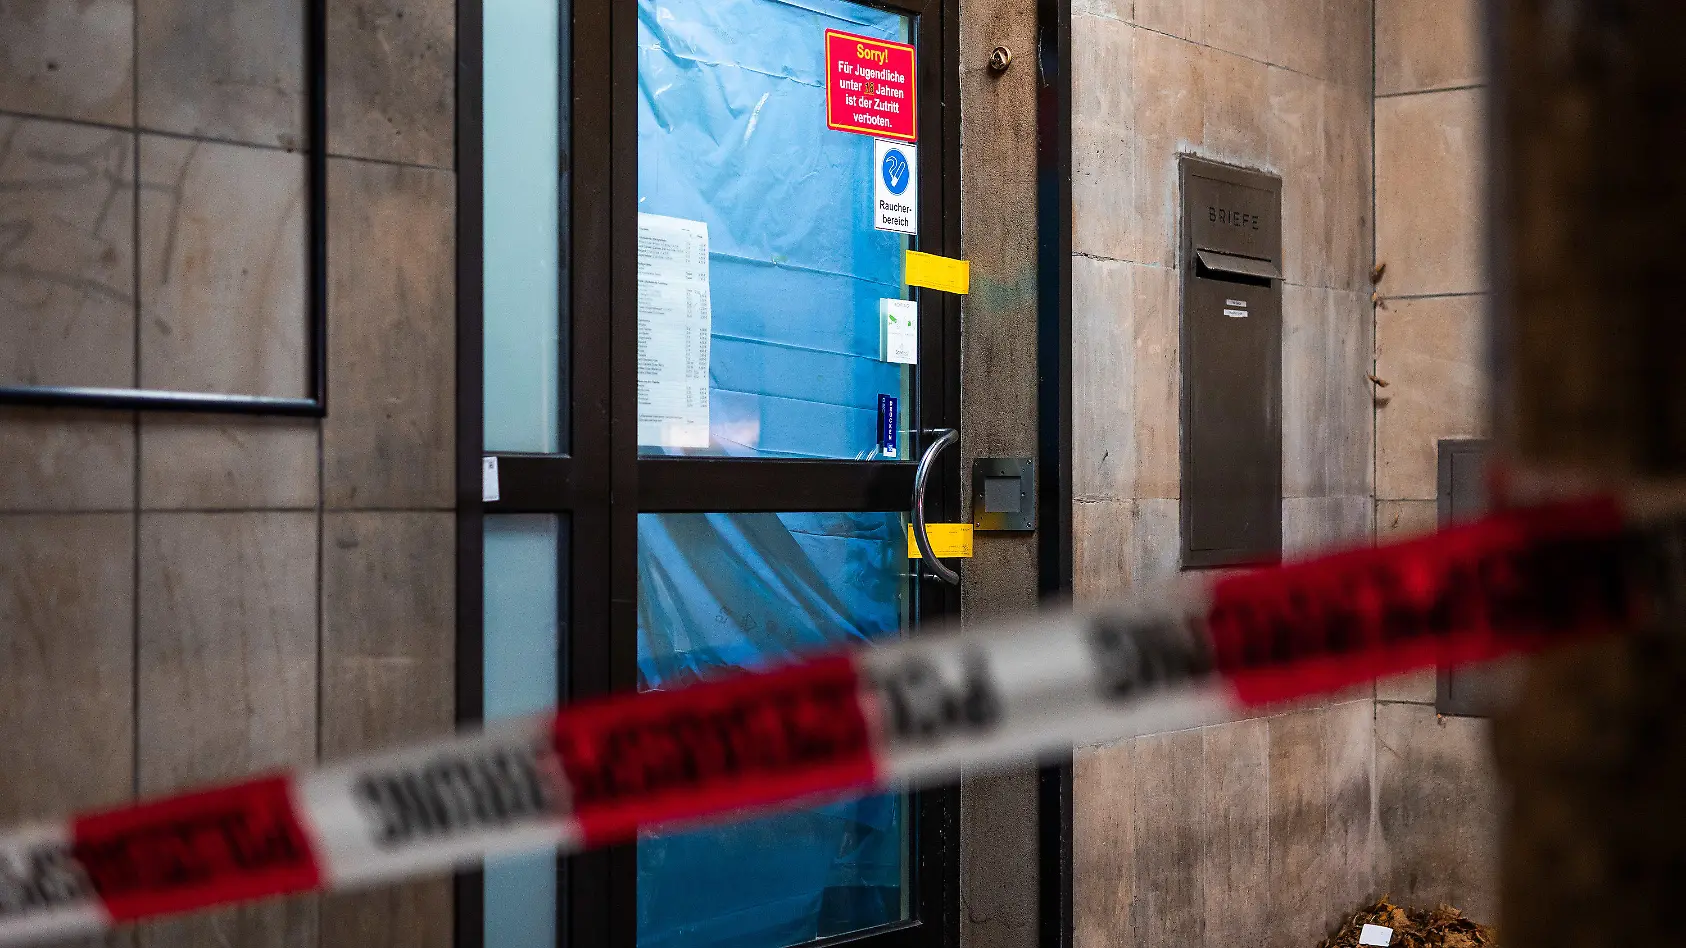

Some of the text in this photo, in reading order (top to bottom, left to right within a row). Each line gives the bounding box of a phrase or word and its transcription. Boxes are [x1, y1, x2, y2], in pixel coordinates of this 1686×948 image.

[856, 44, 889, 65] Sorry!
[838, 60, 905, 84] Für Jugendliche
[839, 79, 862, 92] unter
[876, 84, 904, 99] Jahren
[845, 94, 900, 113] ist der Zutritt
[853, 112, 893, 128] verboten.
[879, 199, 912, 214] Raucher-
[882, 213, 909, 227] bereich
[1209, 206, 1259, 230] BRIEFE
